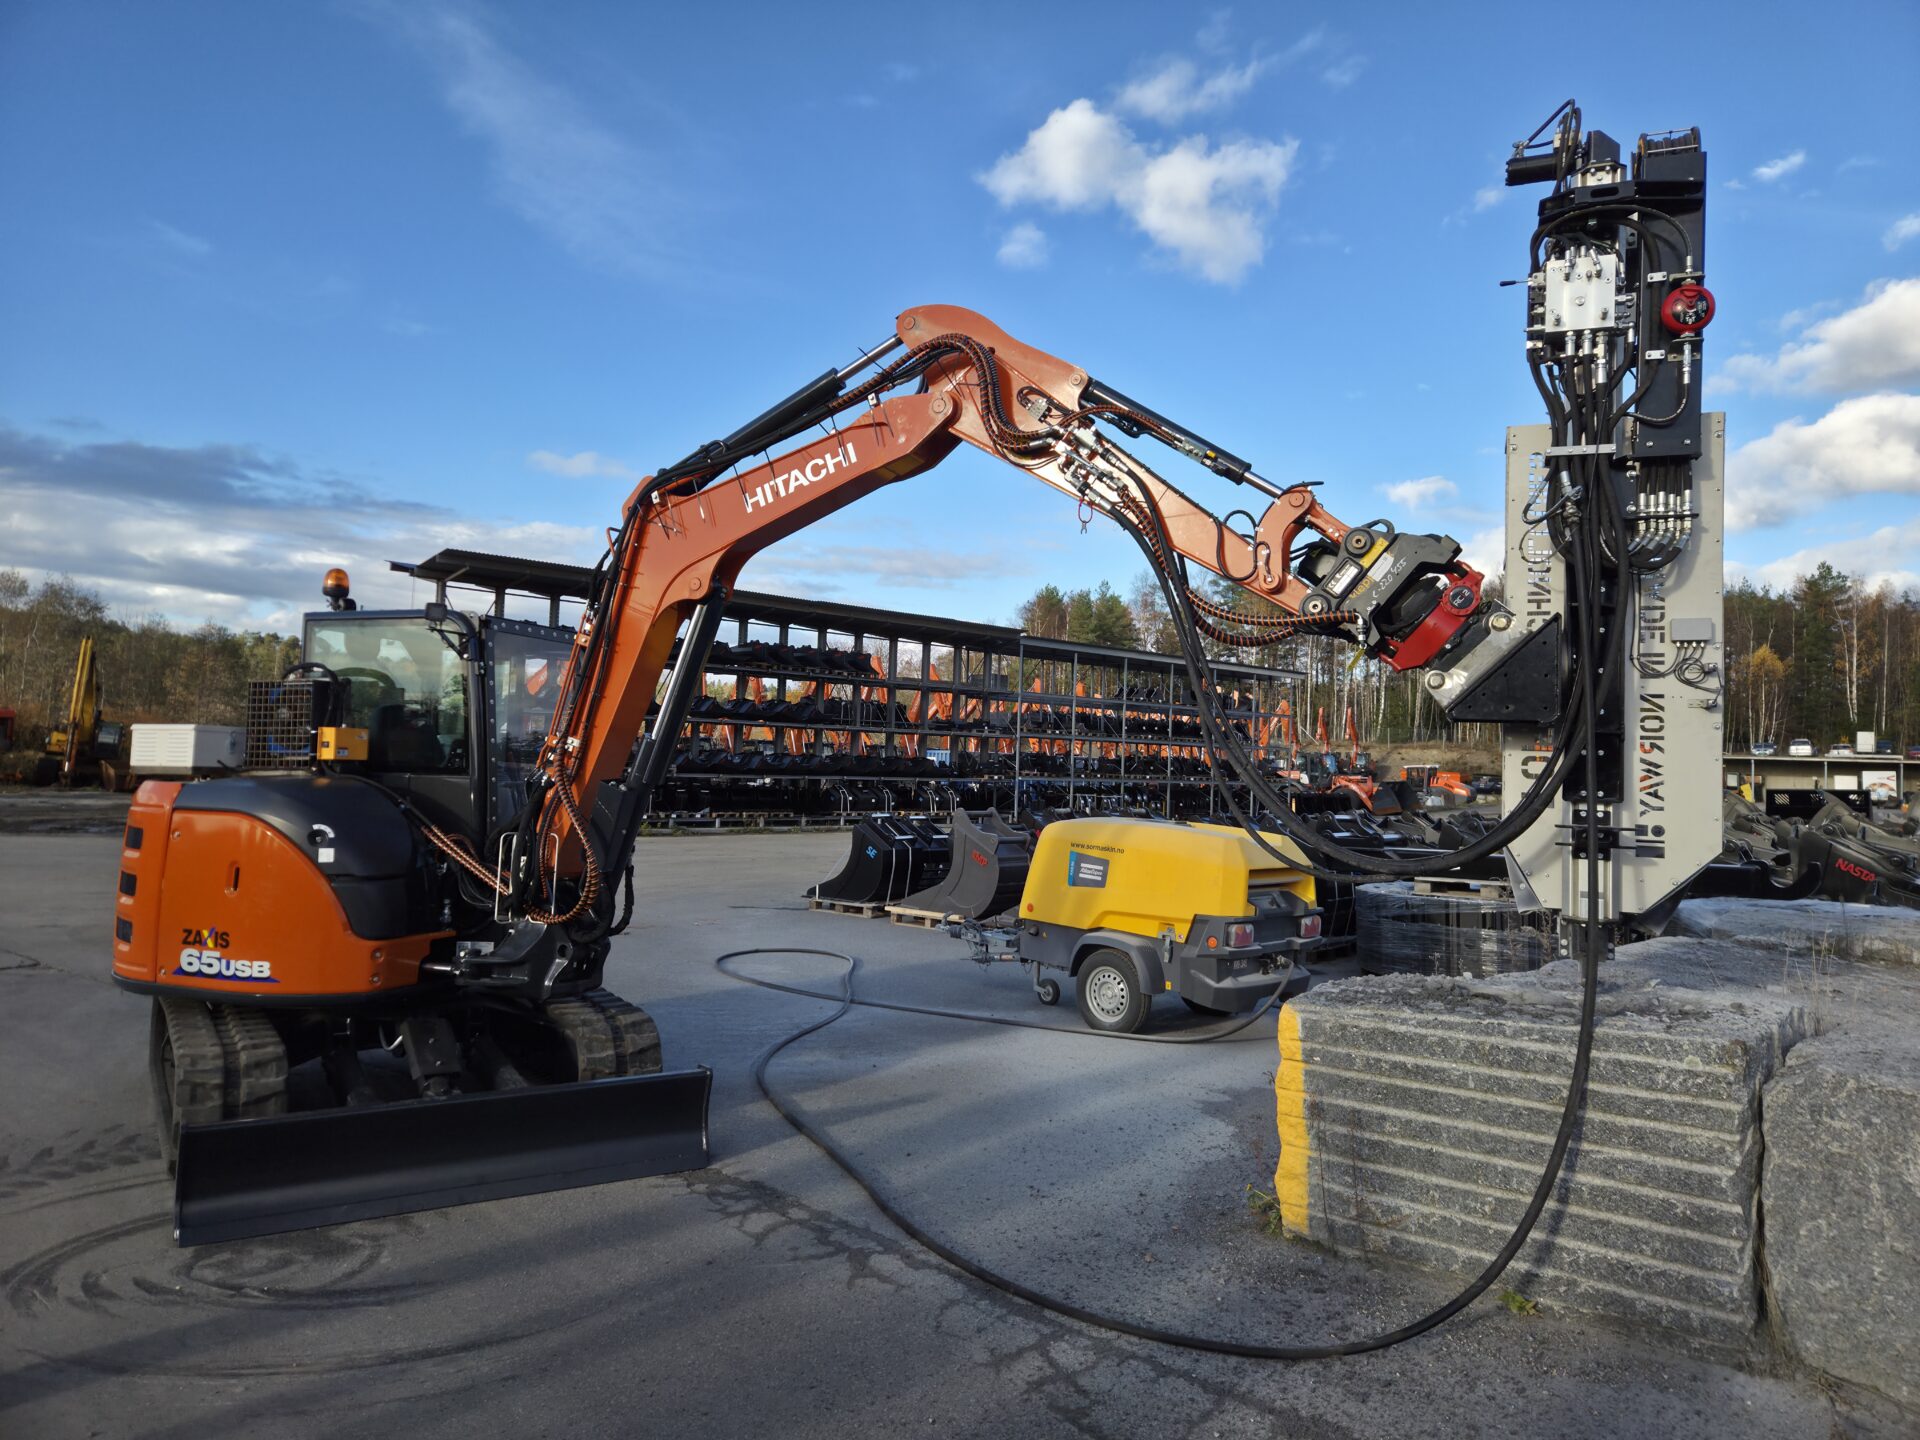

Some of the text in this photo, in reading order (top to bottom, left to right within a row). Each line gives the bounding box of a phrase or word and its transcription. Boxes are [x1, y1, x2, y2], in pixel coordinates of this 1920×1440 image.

[744, 442, 858, 513] HITACHI
[866, 845, 878, 859] SE
[1835, 858, 1877, 881] NASTA
[182, 927, 230, 948] ZAXIS
